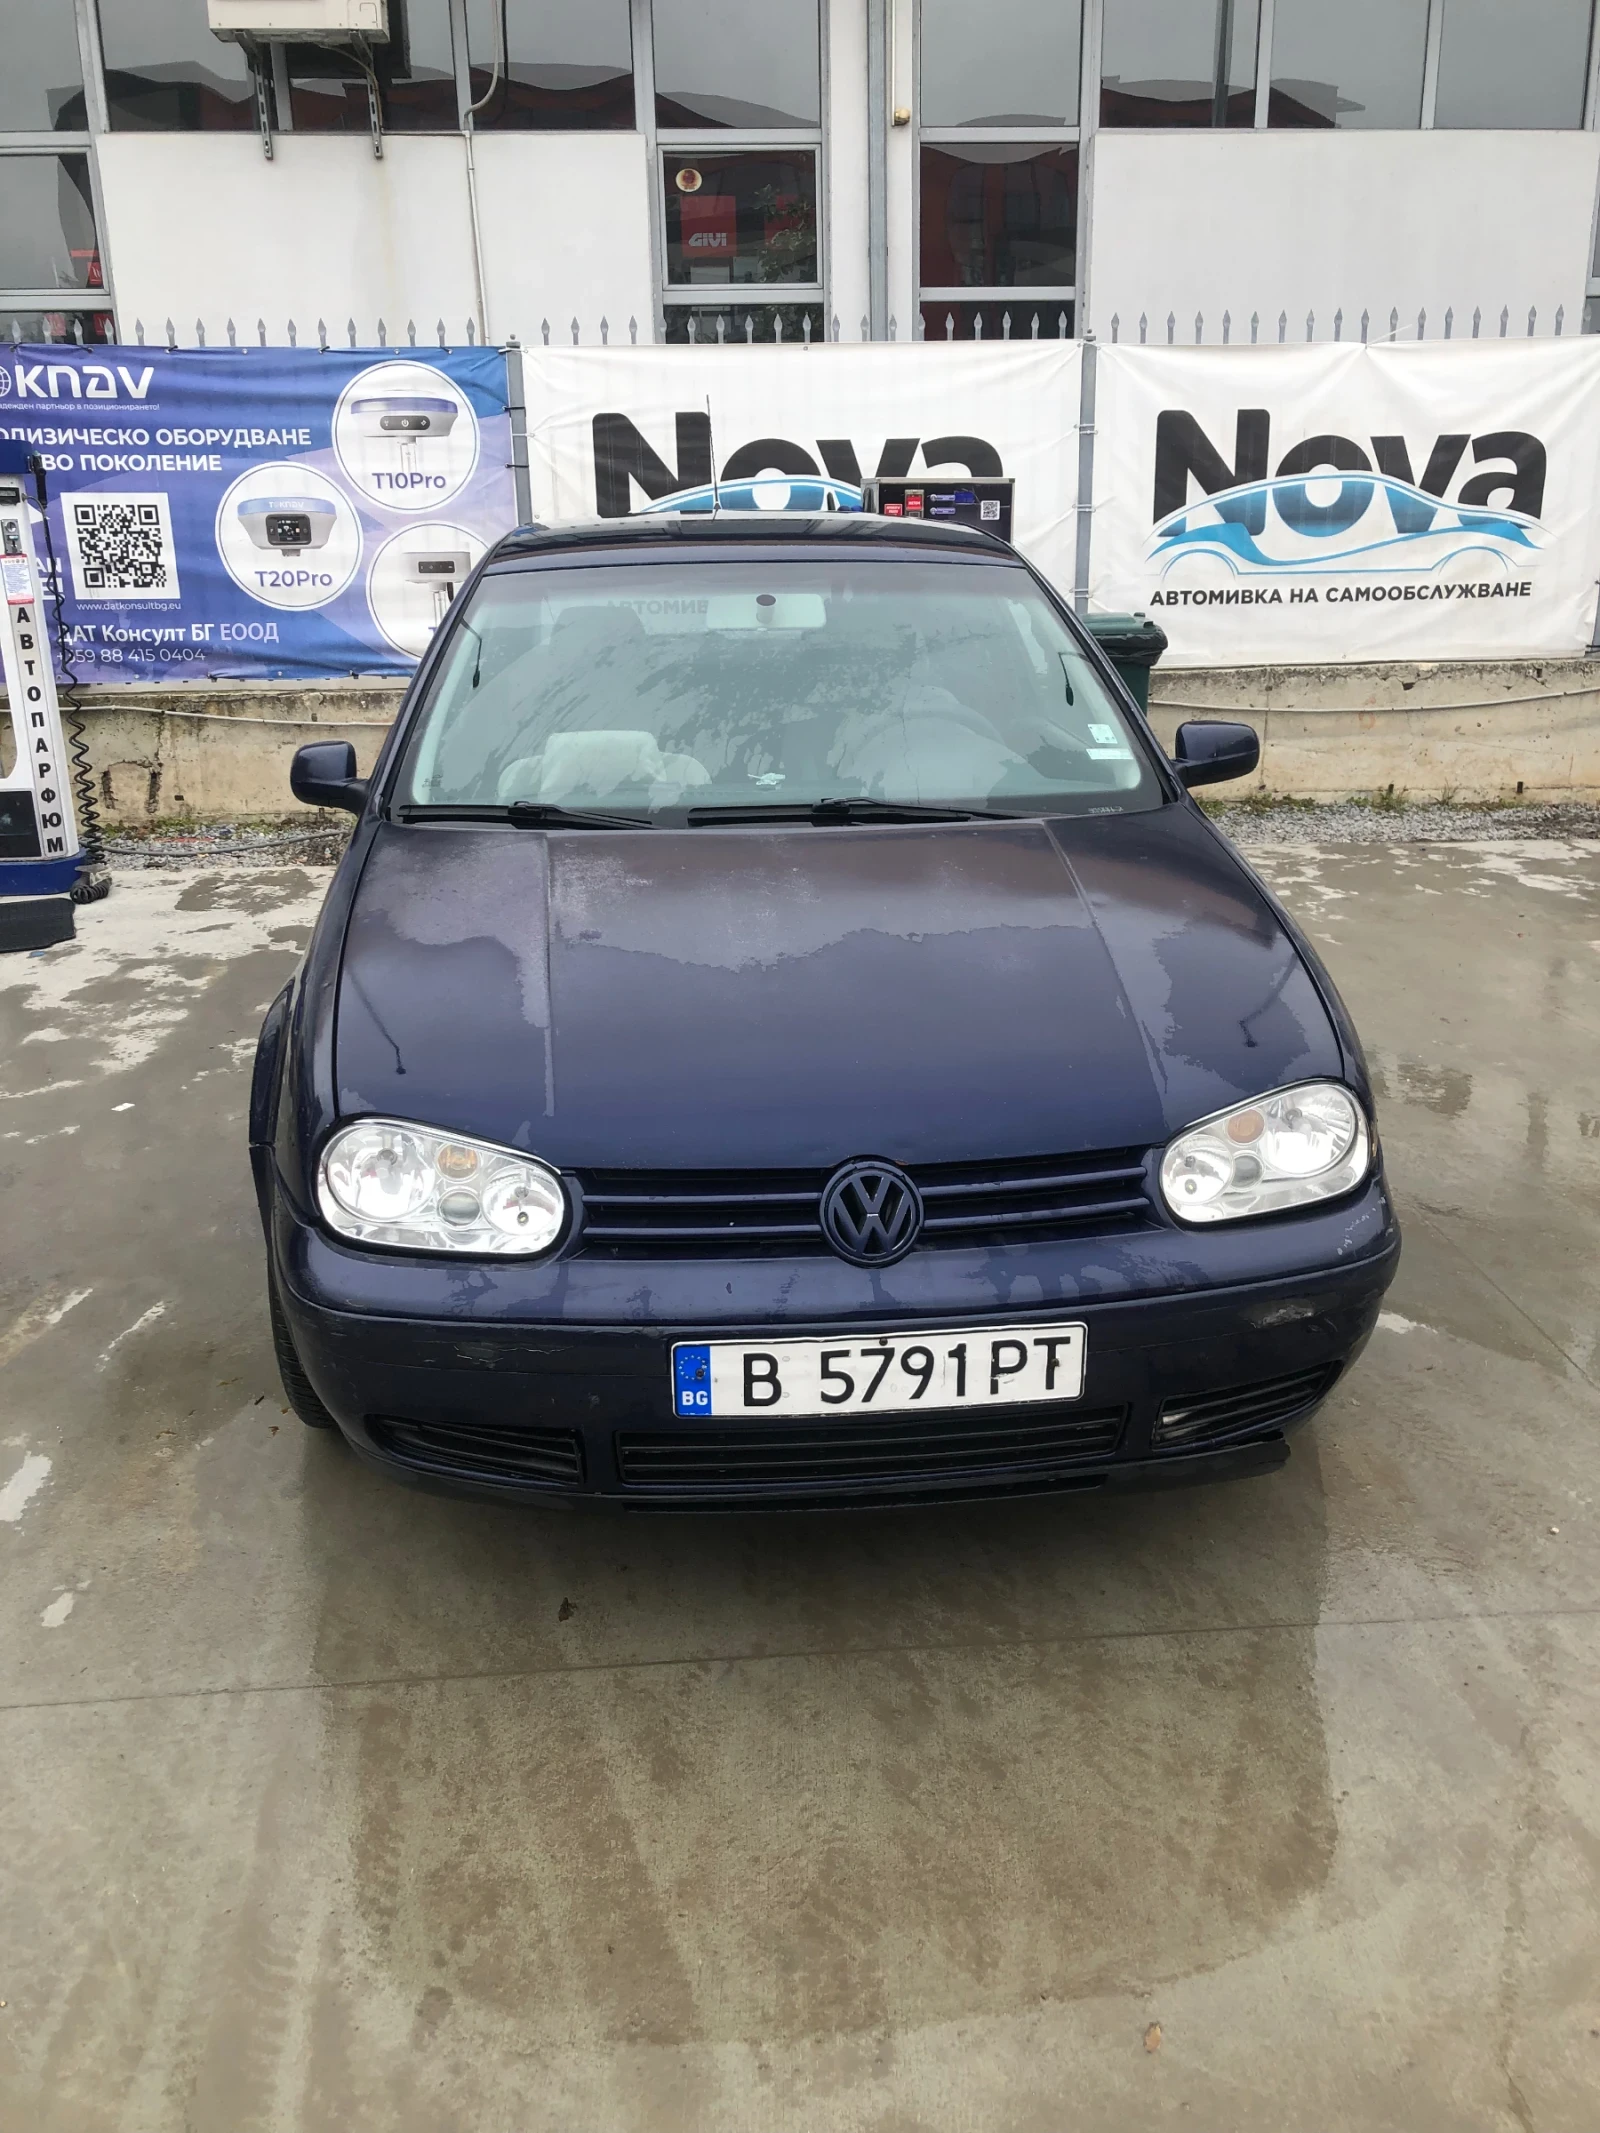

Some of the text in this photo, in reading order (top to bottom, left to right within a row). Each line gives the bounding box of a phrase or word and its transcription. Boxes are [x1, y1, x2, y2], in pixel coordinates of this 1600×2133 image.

[36, 403, 76, 415] партньор
[155, 428, 312, 449] ОБОРУДВАНЕ
[42, 454, 222, 471] ВО ПОКОЛЕНИЕ
[372, 472, 446, 489] T10Pro
[1152, 408, 1548, 538] Nova
[254, 570, 333, 587] T20Pro
[1150, 581, 1533, 606] АВТОМИВКА НА САМООБСЛУЖВАНЕ
[76, 602, 182, 612] www.datkonsultbg.eu
[102, 624, 187, 646] Консулт
[191, 623, 215, 641] БГ
[220, 622, 280, 643] ЕООД
[100, 648, 123, 662] 88
[128, 648, 156, 662] 415
[159, 648, 206, 662] 0404
[17, 607, 64, 853] АВТОПАРФЮМ
[742, 1352, 783, 1407] B
[681, 1390, 709, 1406] BG
